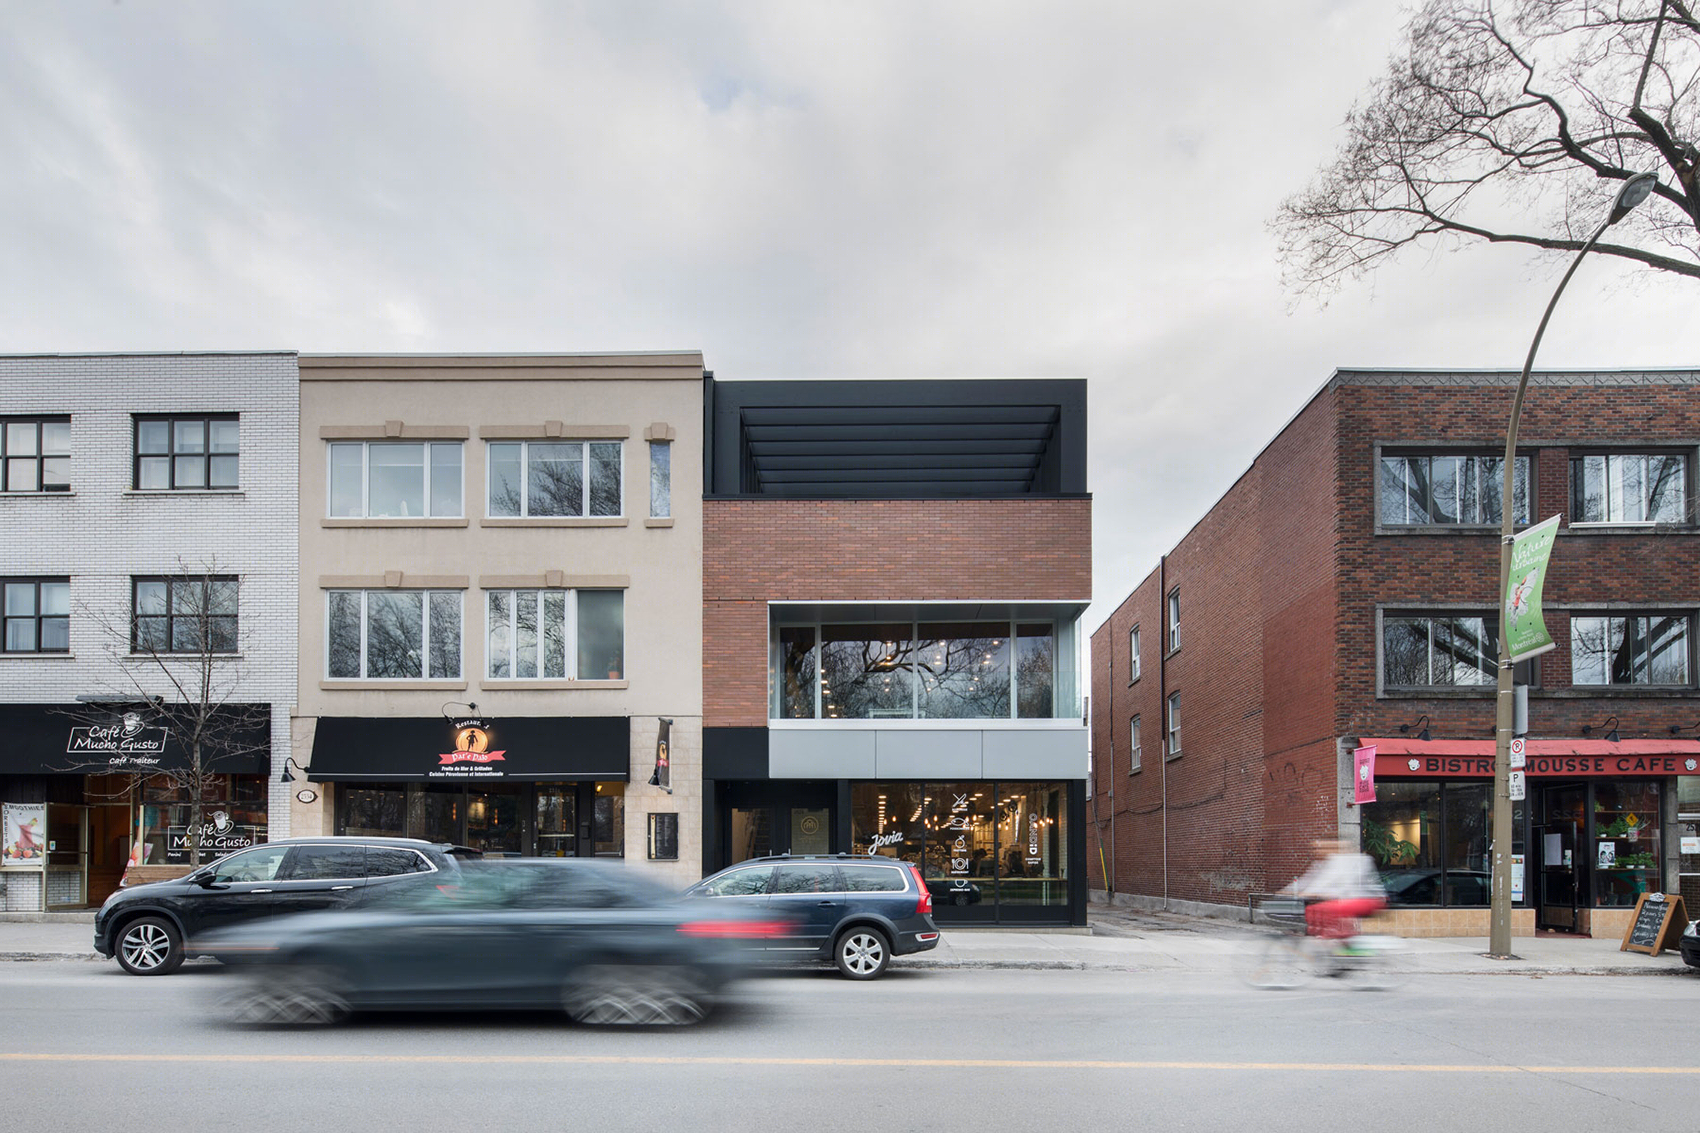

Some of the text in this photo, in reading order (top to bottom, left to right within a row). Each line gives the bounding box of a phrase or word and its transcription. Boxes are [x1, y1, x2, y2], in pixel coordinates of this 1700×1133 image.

[89, 726, 121, 740] Café
[74, 738, 159, 752] Mucho Gusto
[1522, 758, 1604, 772] MOUSSE
[1616, 757, 1676, 771] CAFE
[215, 836, 251, 849] Gusto
[868, 831, 904, 856] Jovia
